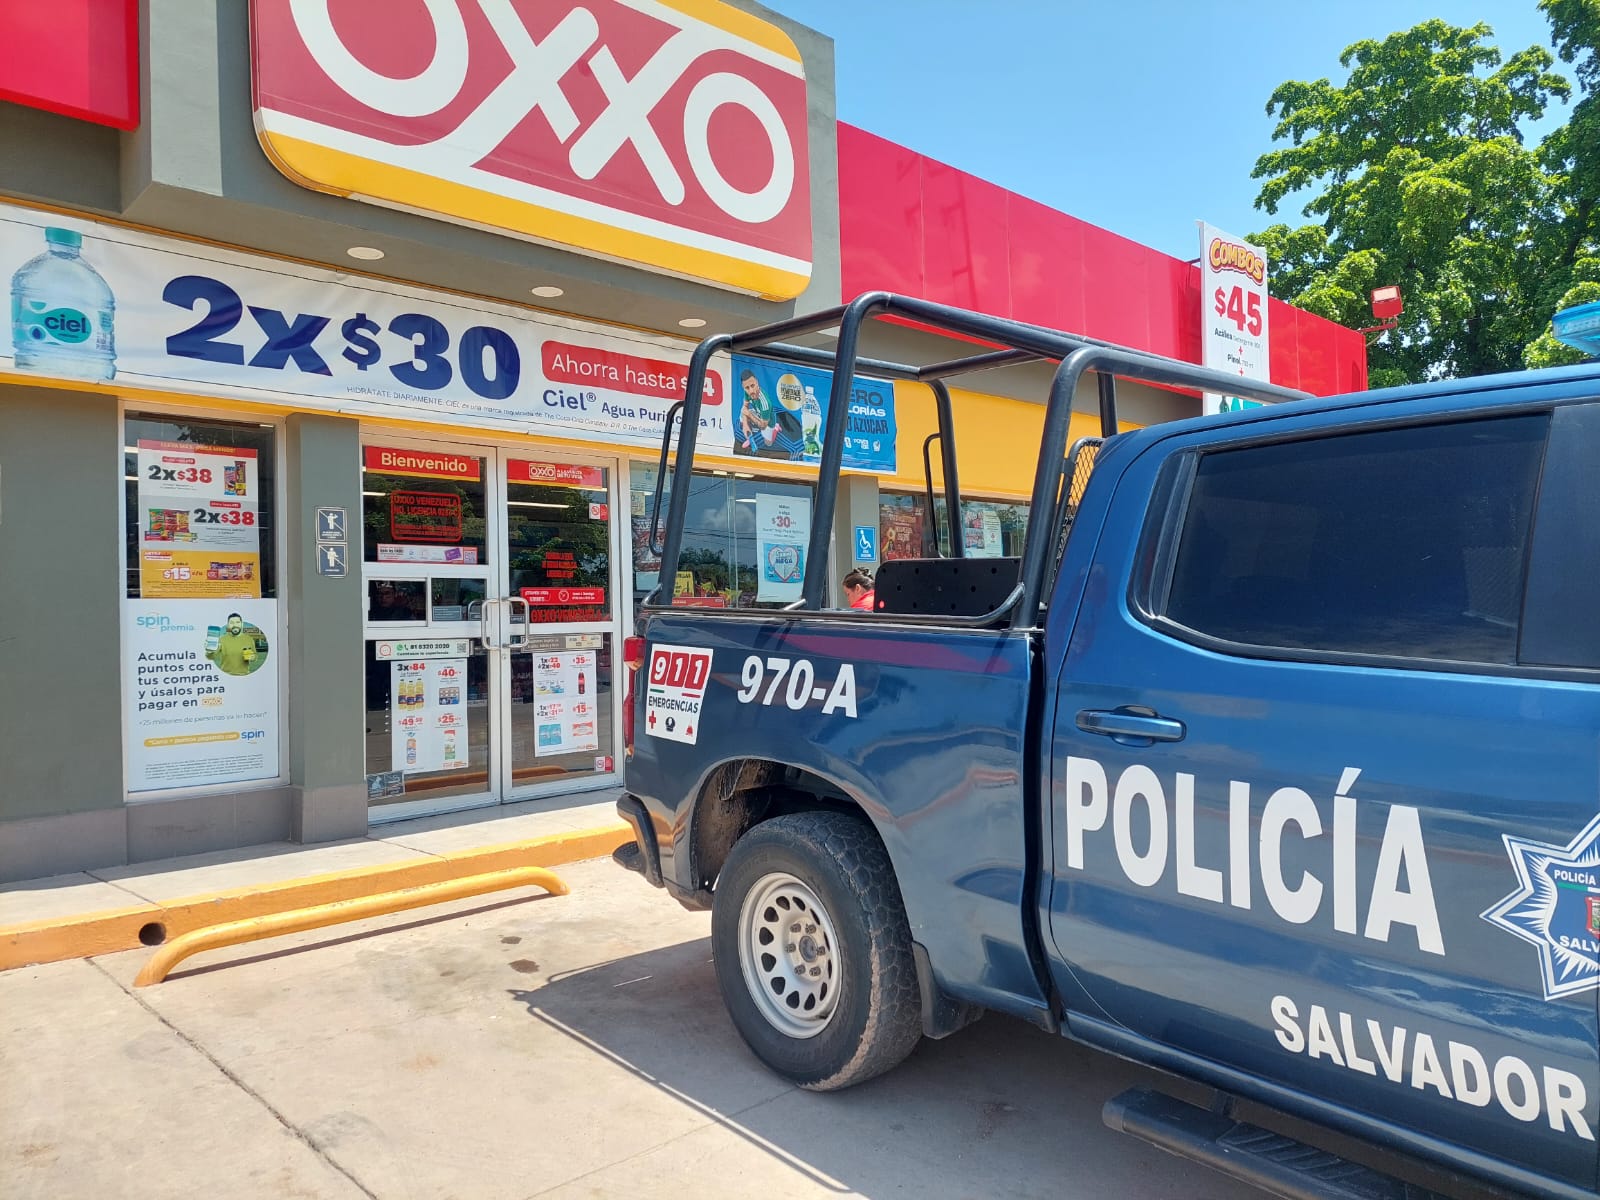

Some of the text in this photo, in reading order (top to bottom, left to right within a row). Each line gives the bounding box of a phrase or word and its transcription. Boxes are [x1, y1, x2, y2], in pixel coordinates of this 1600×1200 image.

[288, 0, 795, 223] OXXO
[1210, 238, 1265, 283] COMBOS
[1214, 285, 1263, 336] $45
[44, 315, 88, 335] ciel
[552, 353, 619, 380] Ahorra
[625, 364, 677, 391] hasta
[601, 402, 635, 419] Agua
[381, 452, 468, 473] Bienvenido
[530, 466, 555, 477] OXXO
[163, 567, 191, 580] $15
[136, 614, 170, 628] spin
[160, 623, 195, 632] premia
[138, 651, 196, 662] Acumula
[138, 662, 212, 675] puntos con
[653, 655, 703, 690] 911
[138, 673, 219, 686] tus compras
[737, 655, 858, 718] 970-A
[138, 684, 225, 700] y úsalos para
[138, 699, 178, 712] pagar
[182, 698, 198, 708] en
[648, 695, 699, 714] EMERGENCIAS
[241, 730, 265, 740] spin
[1067, 756, 1445, 956] POLICÍA
[1554, 869, 1596, 885] POLICÍA
[1270, 995, 1596, 1141] SALVADOR
